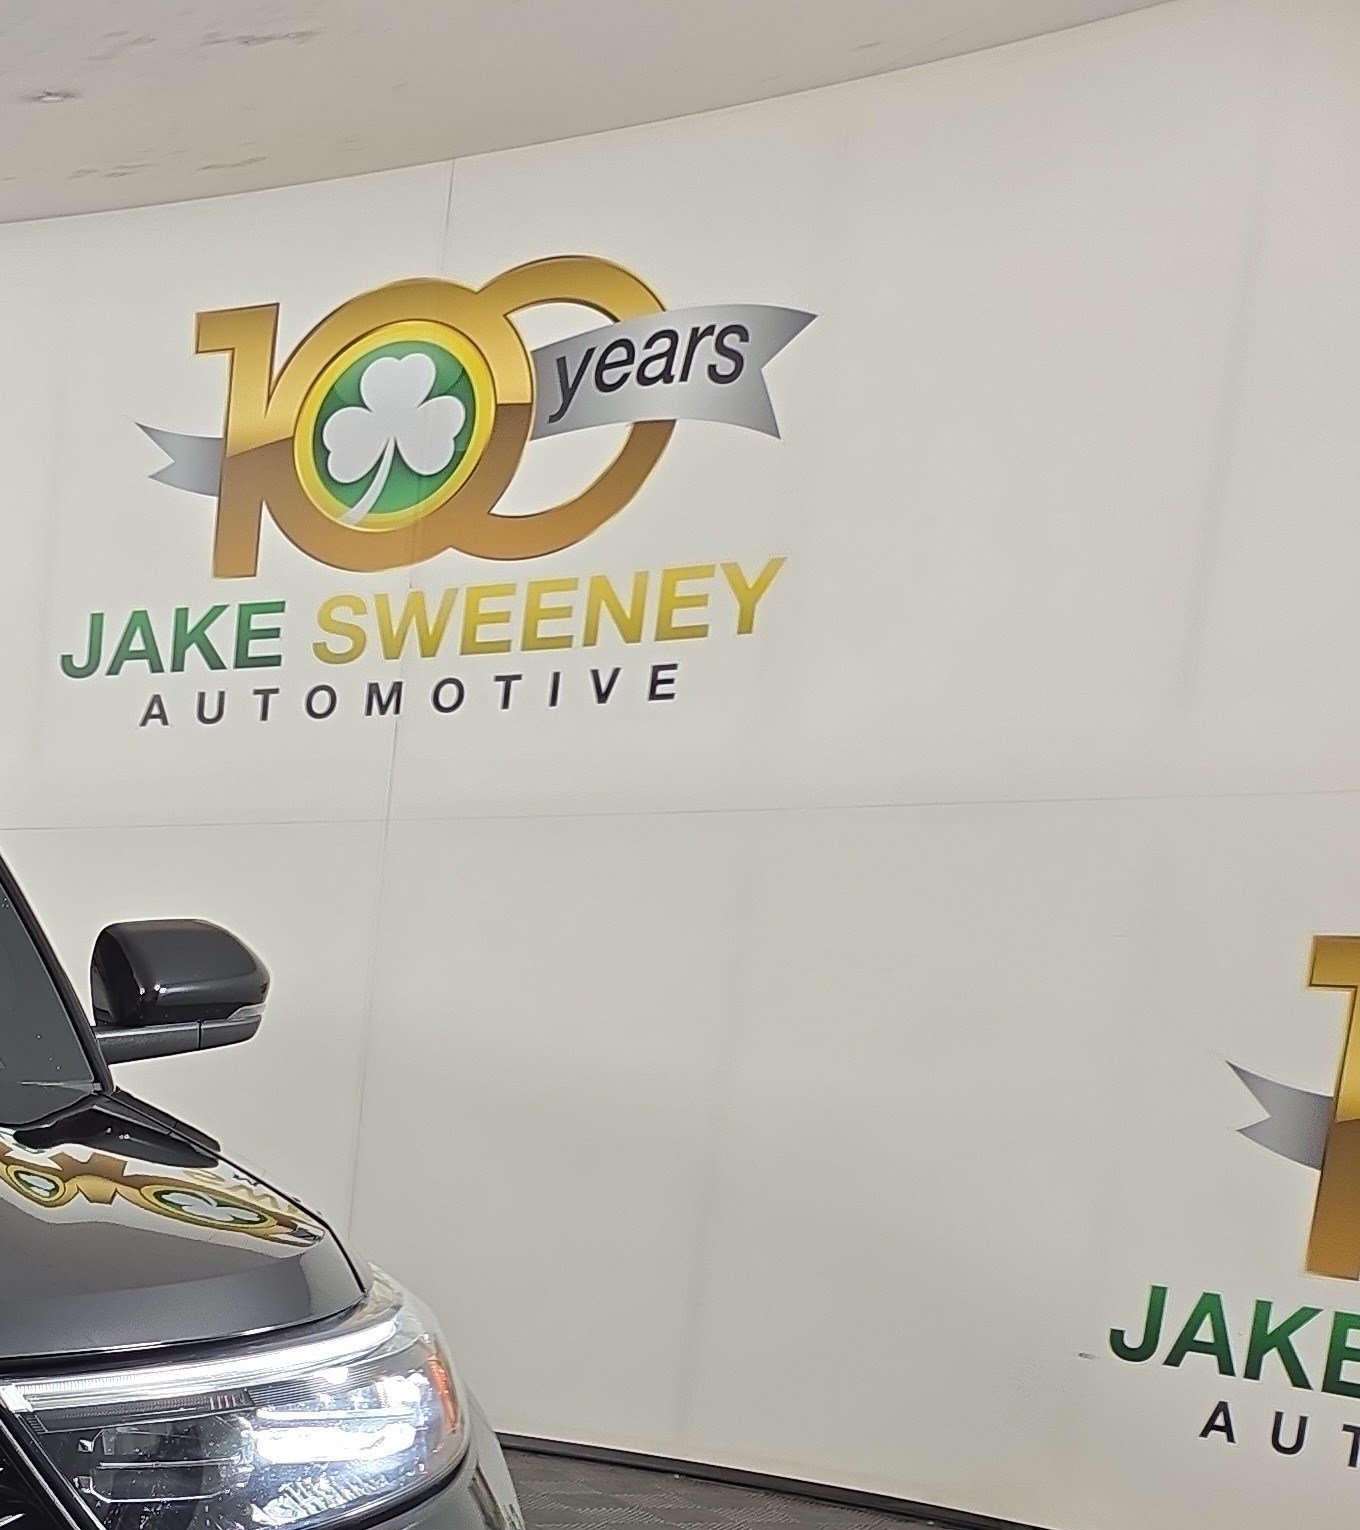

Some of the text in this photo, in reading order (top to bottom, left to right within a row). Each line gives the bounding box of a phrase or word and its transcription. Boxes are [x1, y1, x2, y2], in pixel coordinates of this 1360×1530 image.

[195, 254, 676, 578] 100
[547, 322, 751, 424] years
[59, 557, 787, 680] JAKE SWEENEY
[140, 663, 679, 727] AUTOMOTIVE
